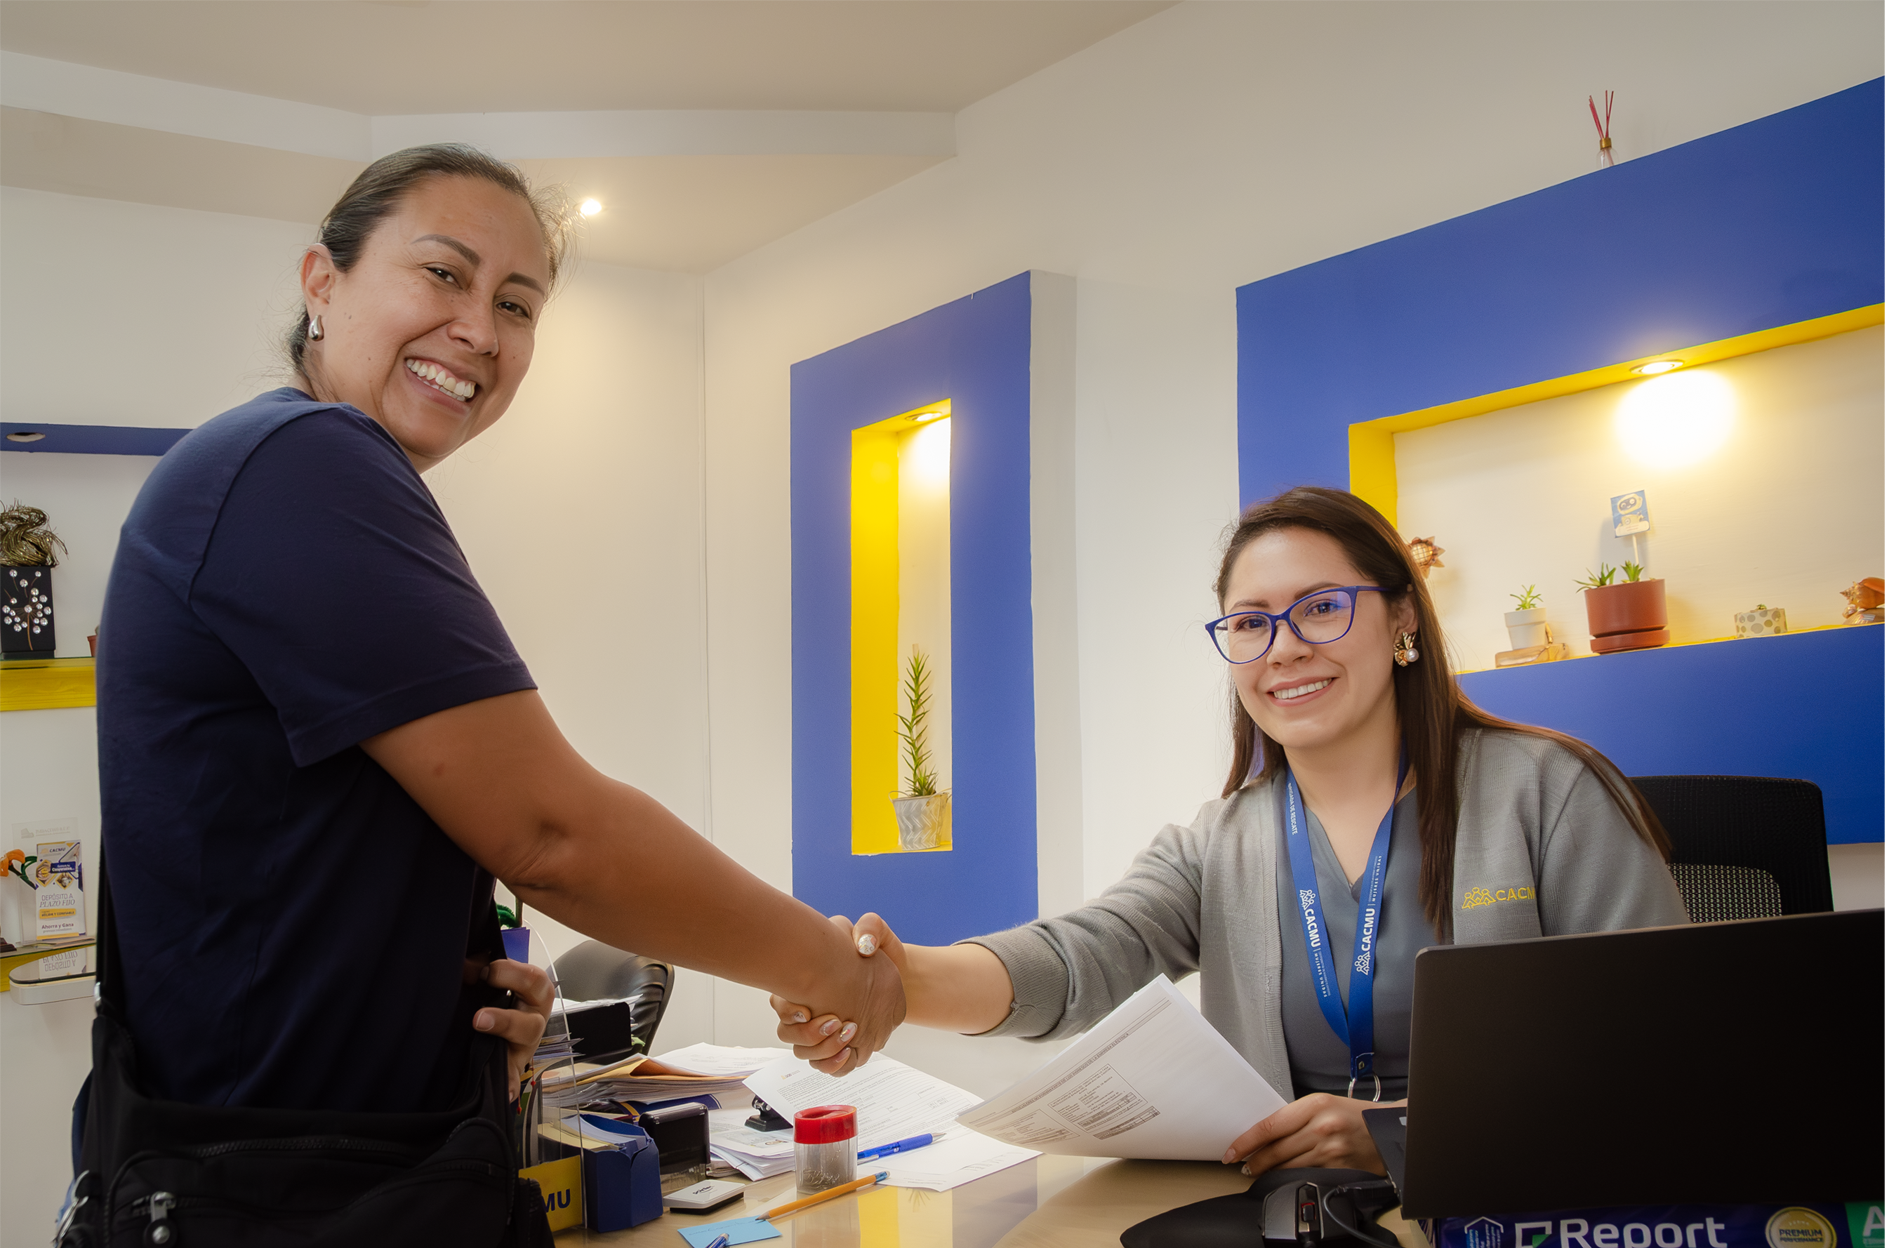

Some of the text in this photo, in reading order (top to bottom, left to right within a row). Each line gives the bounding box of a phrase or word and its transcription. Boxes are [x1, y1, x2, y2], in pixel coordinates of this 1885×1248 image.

[1290, 811, 1298, 836] RESCATE
[1304, 908, 1321, 948] CACMU
[1363, 908, 1376, 951] CACMU
[1560, 1217, 1728, 1248] Report
[1779, 1228, 1823, 1237] PREMIUM
